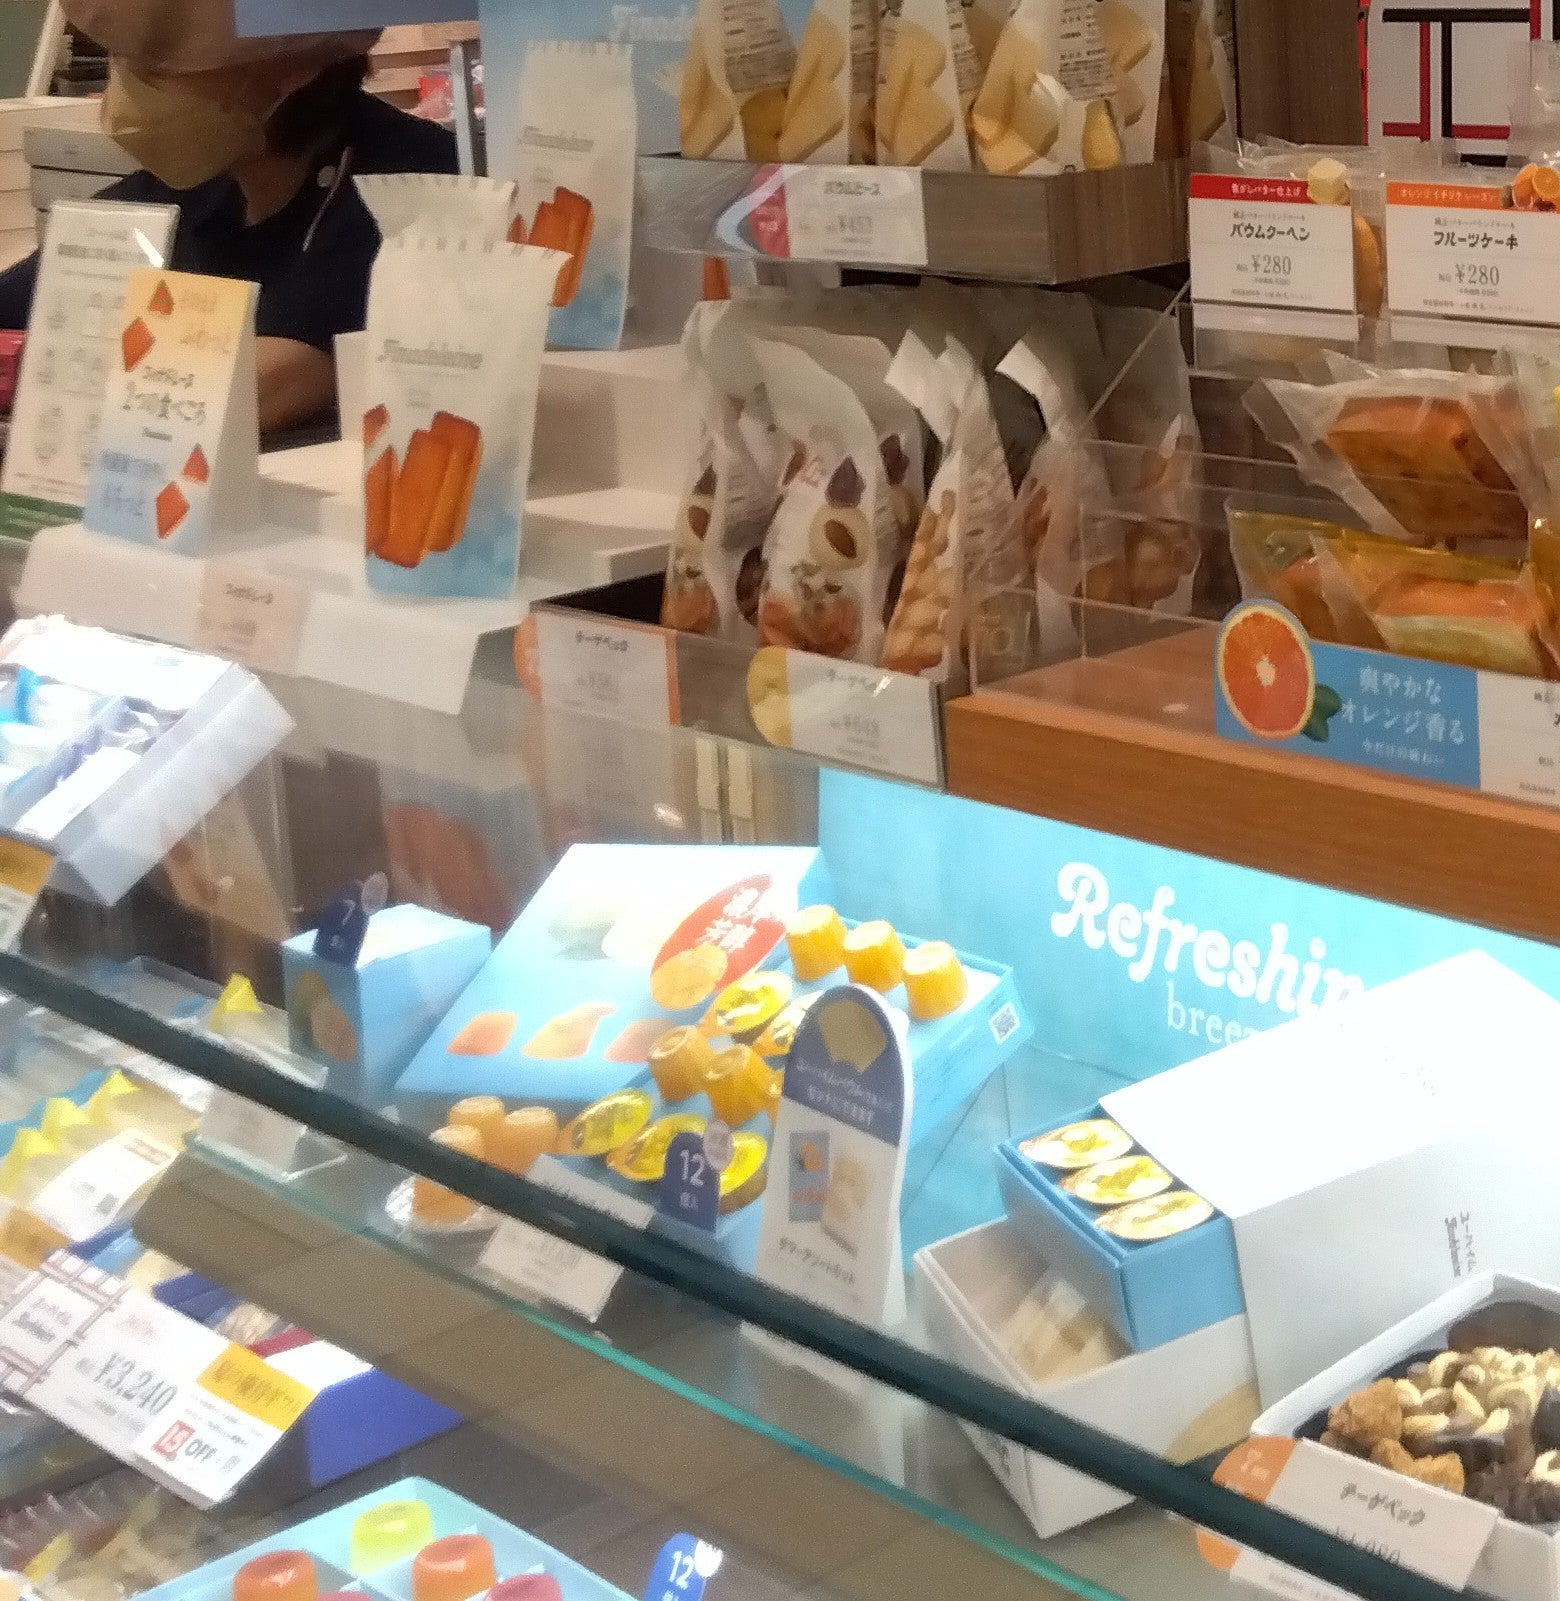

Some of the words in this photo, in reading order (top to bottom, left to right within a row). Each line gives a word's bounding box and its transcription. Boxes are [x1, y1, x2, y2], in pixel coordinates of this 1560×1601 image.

[1230, 222, 1311, 241] バウムクーヘン
[1433, 231, 1519, 251] フルーツケーキ
[1250, 254, 1292, 276] ¥280
[1455, 263, 1500, 286] ¥280
[1165, 977, 1260, 1046] bree
[679, 1149, 704, 1187] 12
[668, 1550, 695, 1591] 12
